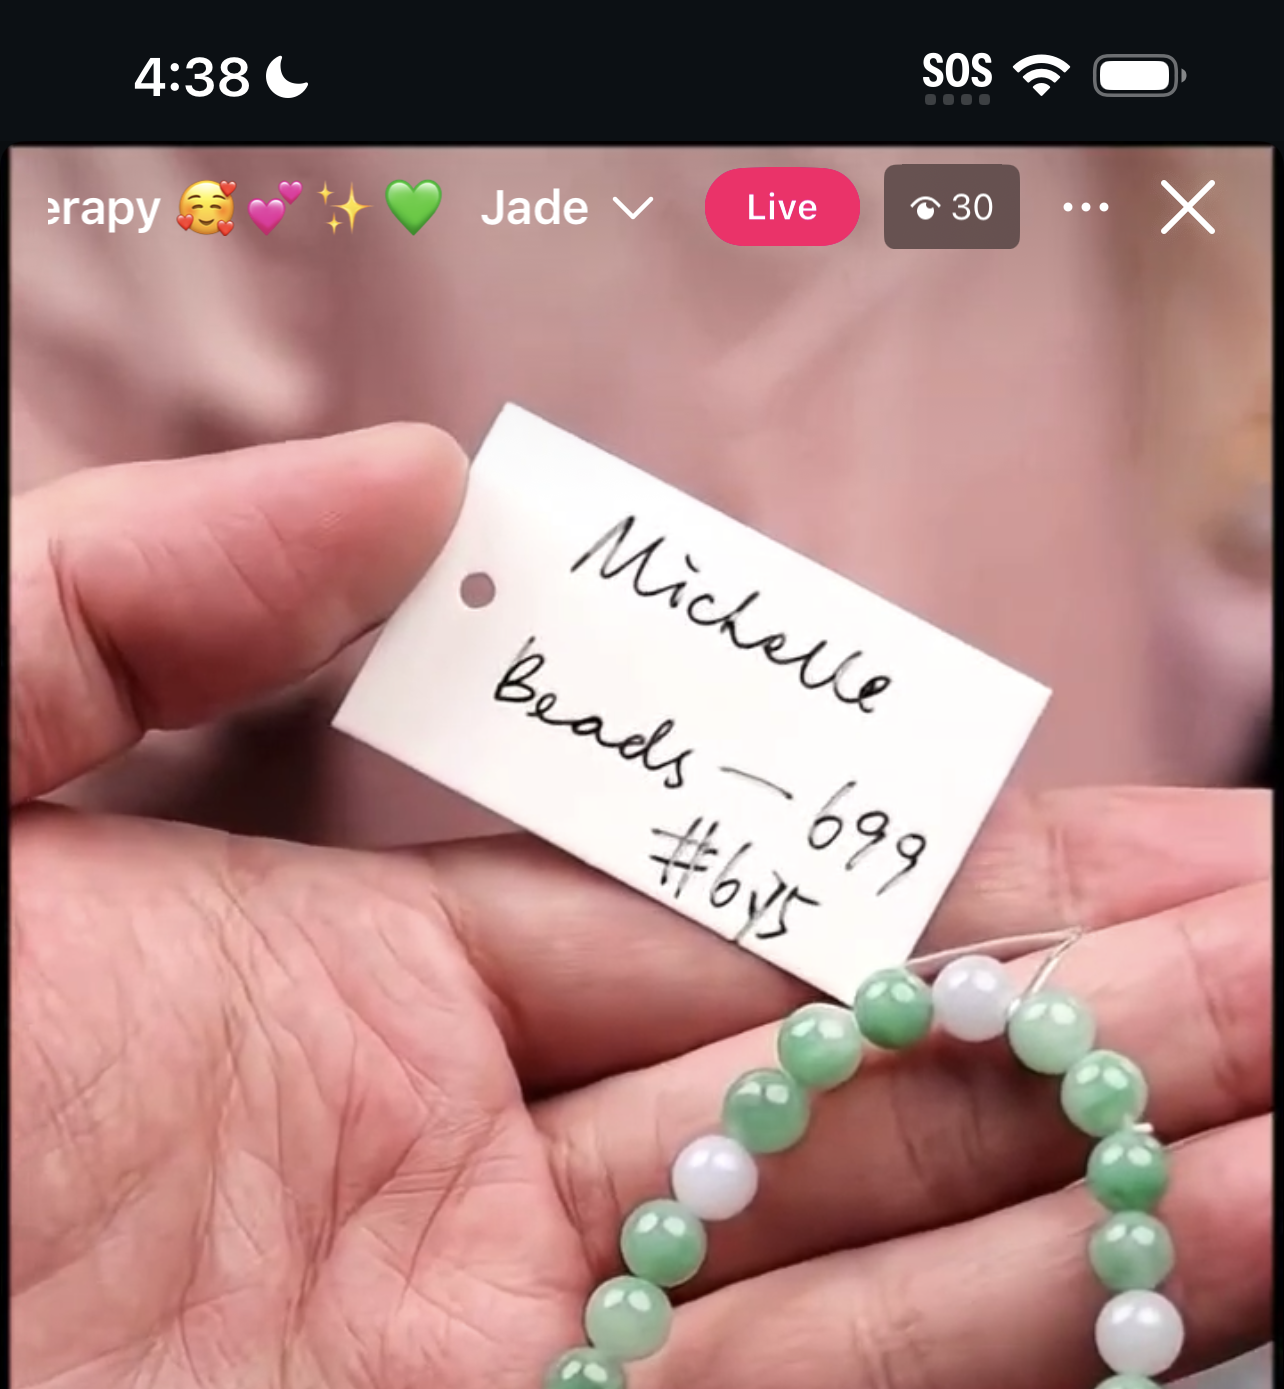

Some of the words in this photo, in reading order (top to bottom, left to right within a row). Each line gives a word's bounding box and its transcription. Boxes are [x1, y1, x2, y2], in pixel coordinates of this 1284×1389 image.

[571, 515, 891, 713] Michelle
[494, 636, 693, 789] Beads
[807, 780, 928, 896] 699
